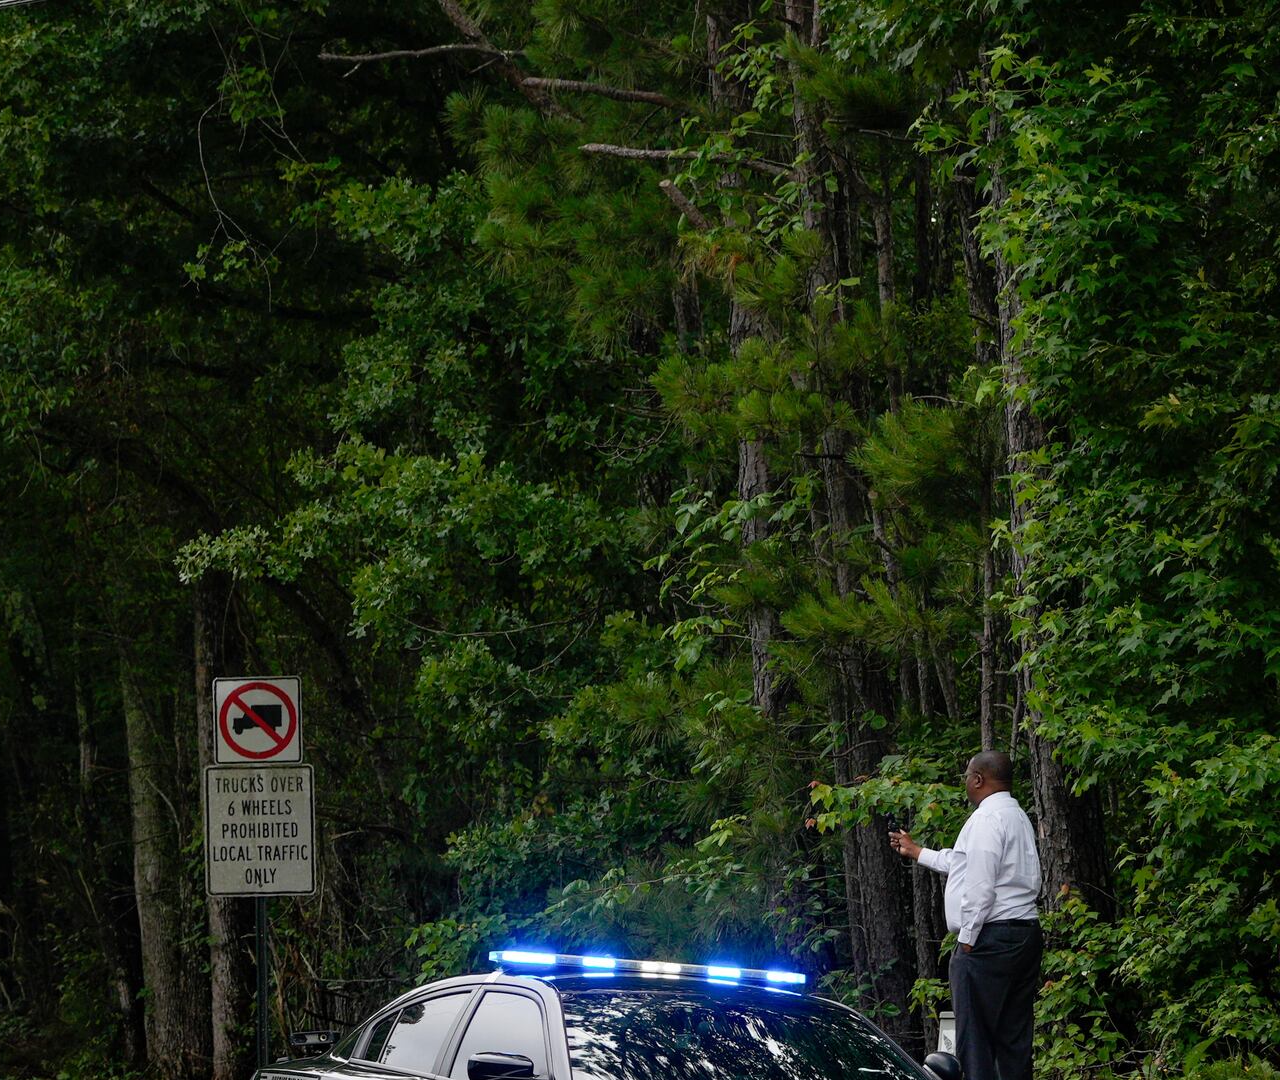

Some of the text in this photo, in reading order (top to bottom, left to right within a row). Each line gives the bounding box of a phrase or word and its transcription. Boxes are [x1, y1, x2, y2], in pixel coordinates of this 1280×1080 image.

[215, 776, 304, 793] TRUCKS OVER
[227, 799, 292, 817] 6 WHEELS
[222, 822, 298, 839] PROHIBITED
[213, 845, 308, 862] LOCAL TRAFFIC
[245, 868, 277, 885] ONLY
